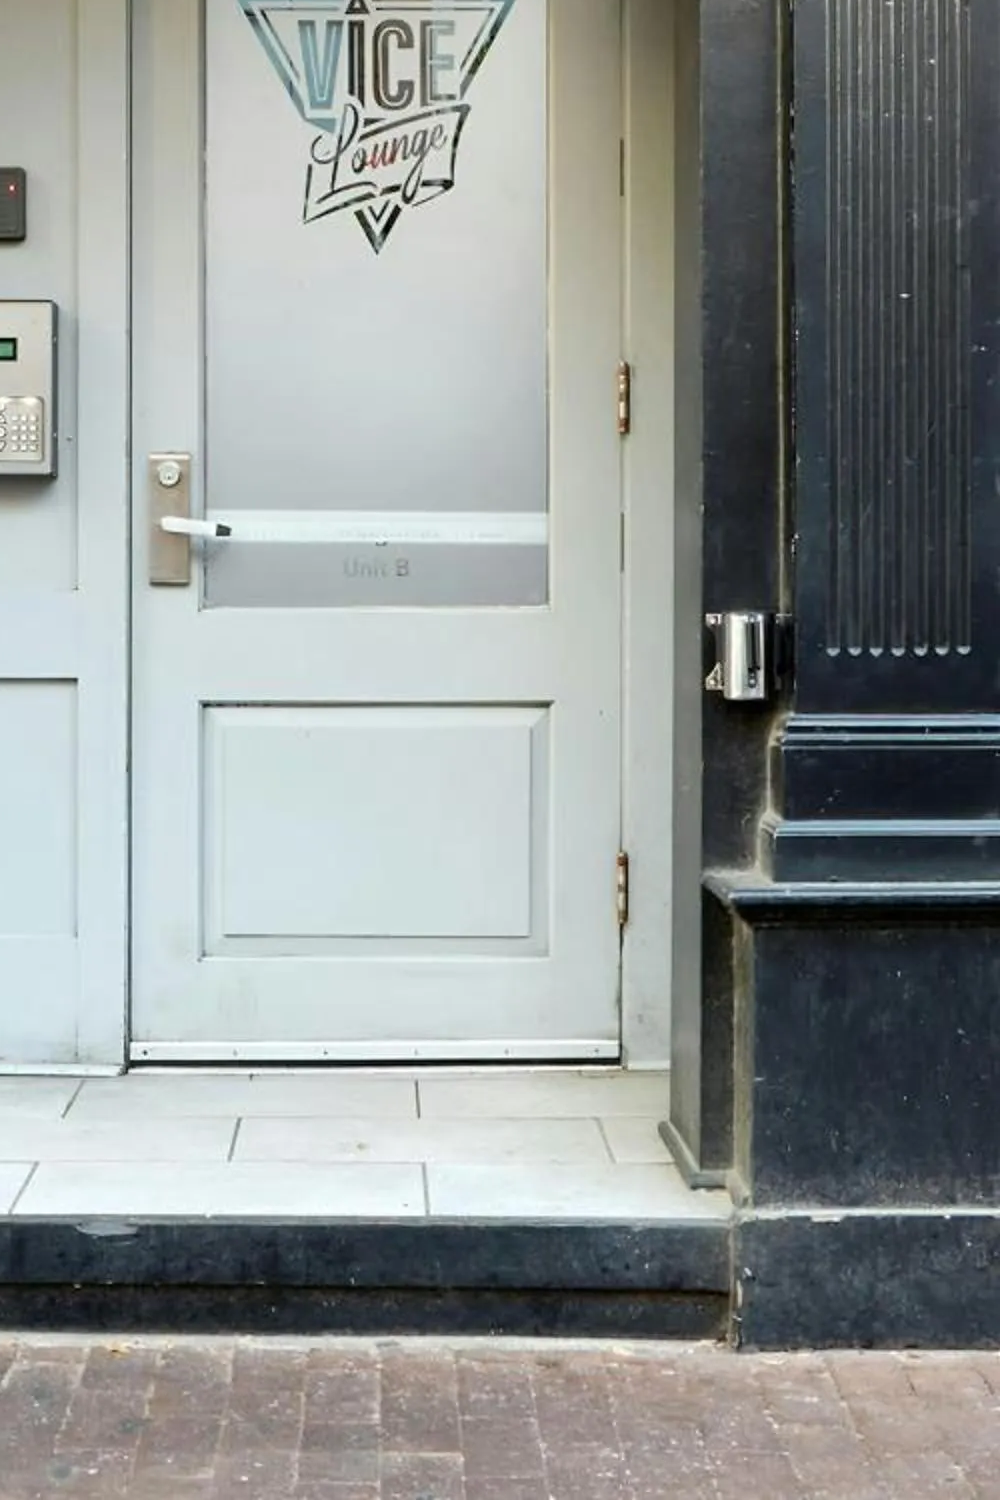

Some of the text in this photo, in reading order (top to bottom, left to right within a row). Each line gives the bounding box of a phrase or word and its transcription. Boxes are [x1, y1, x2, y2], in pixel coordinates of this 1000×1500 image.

[297, 18, 457, 112] VICE
[310, 103, 449, 205] Lounge
[396, 558, 409, 577] B
